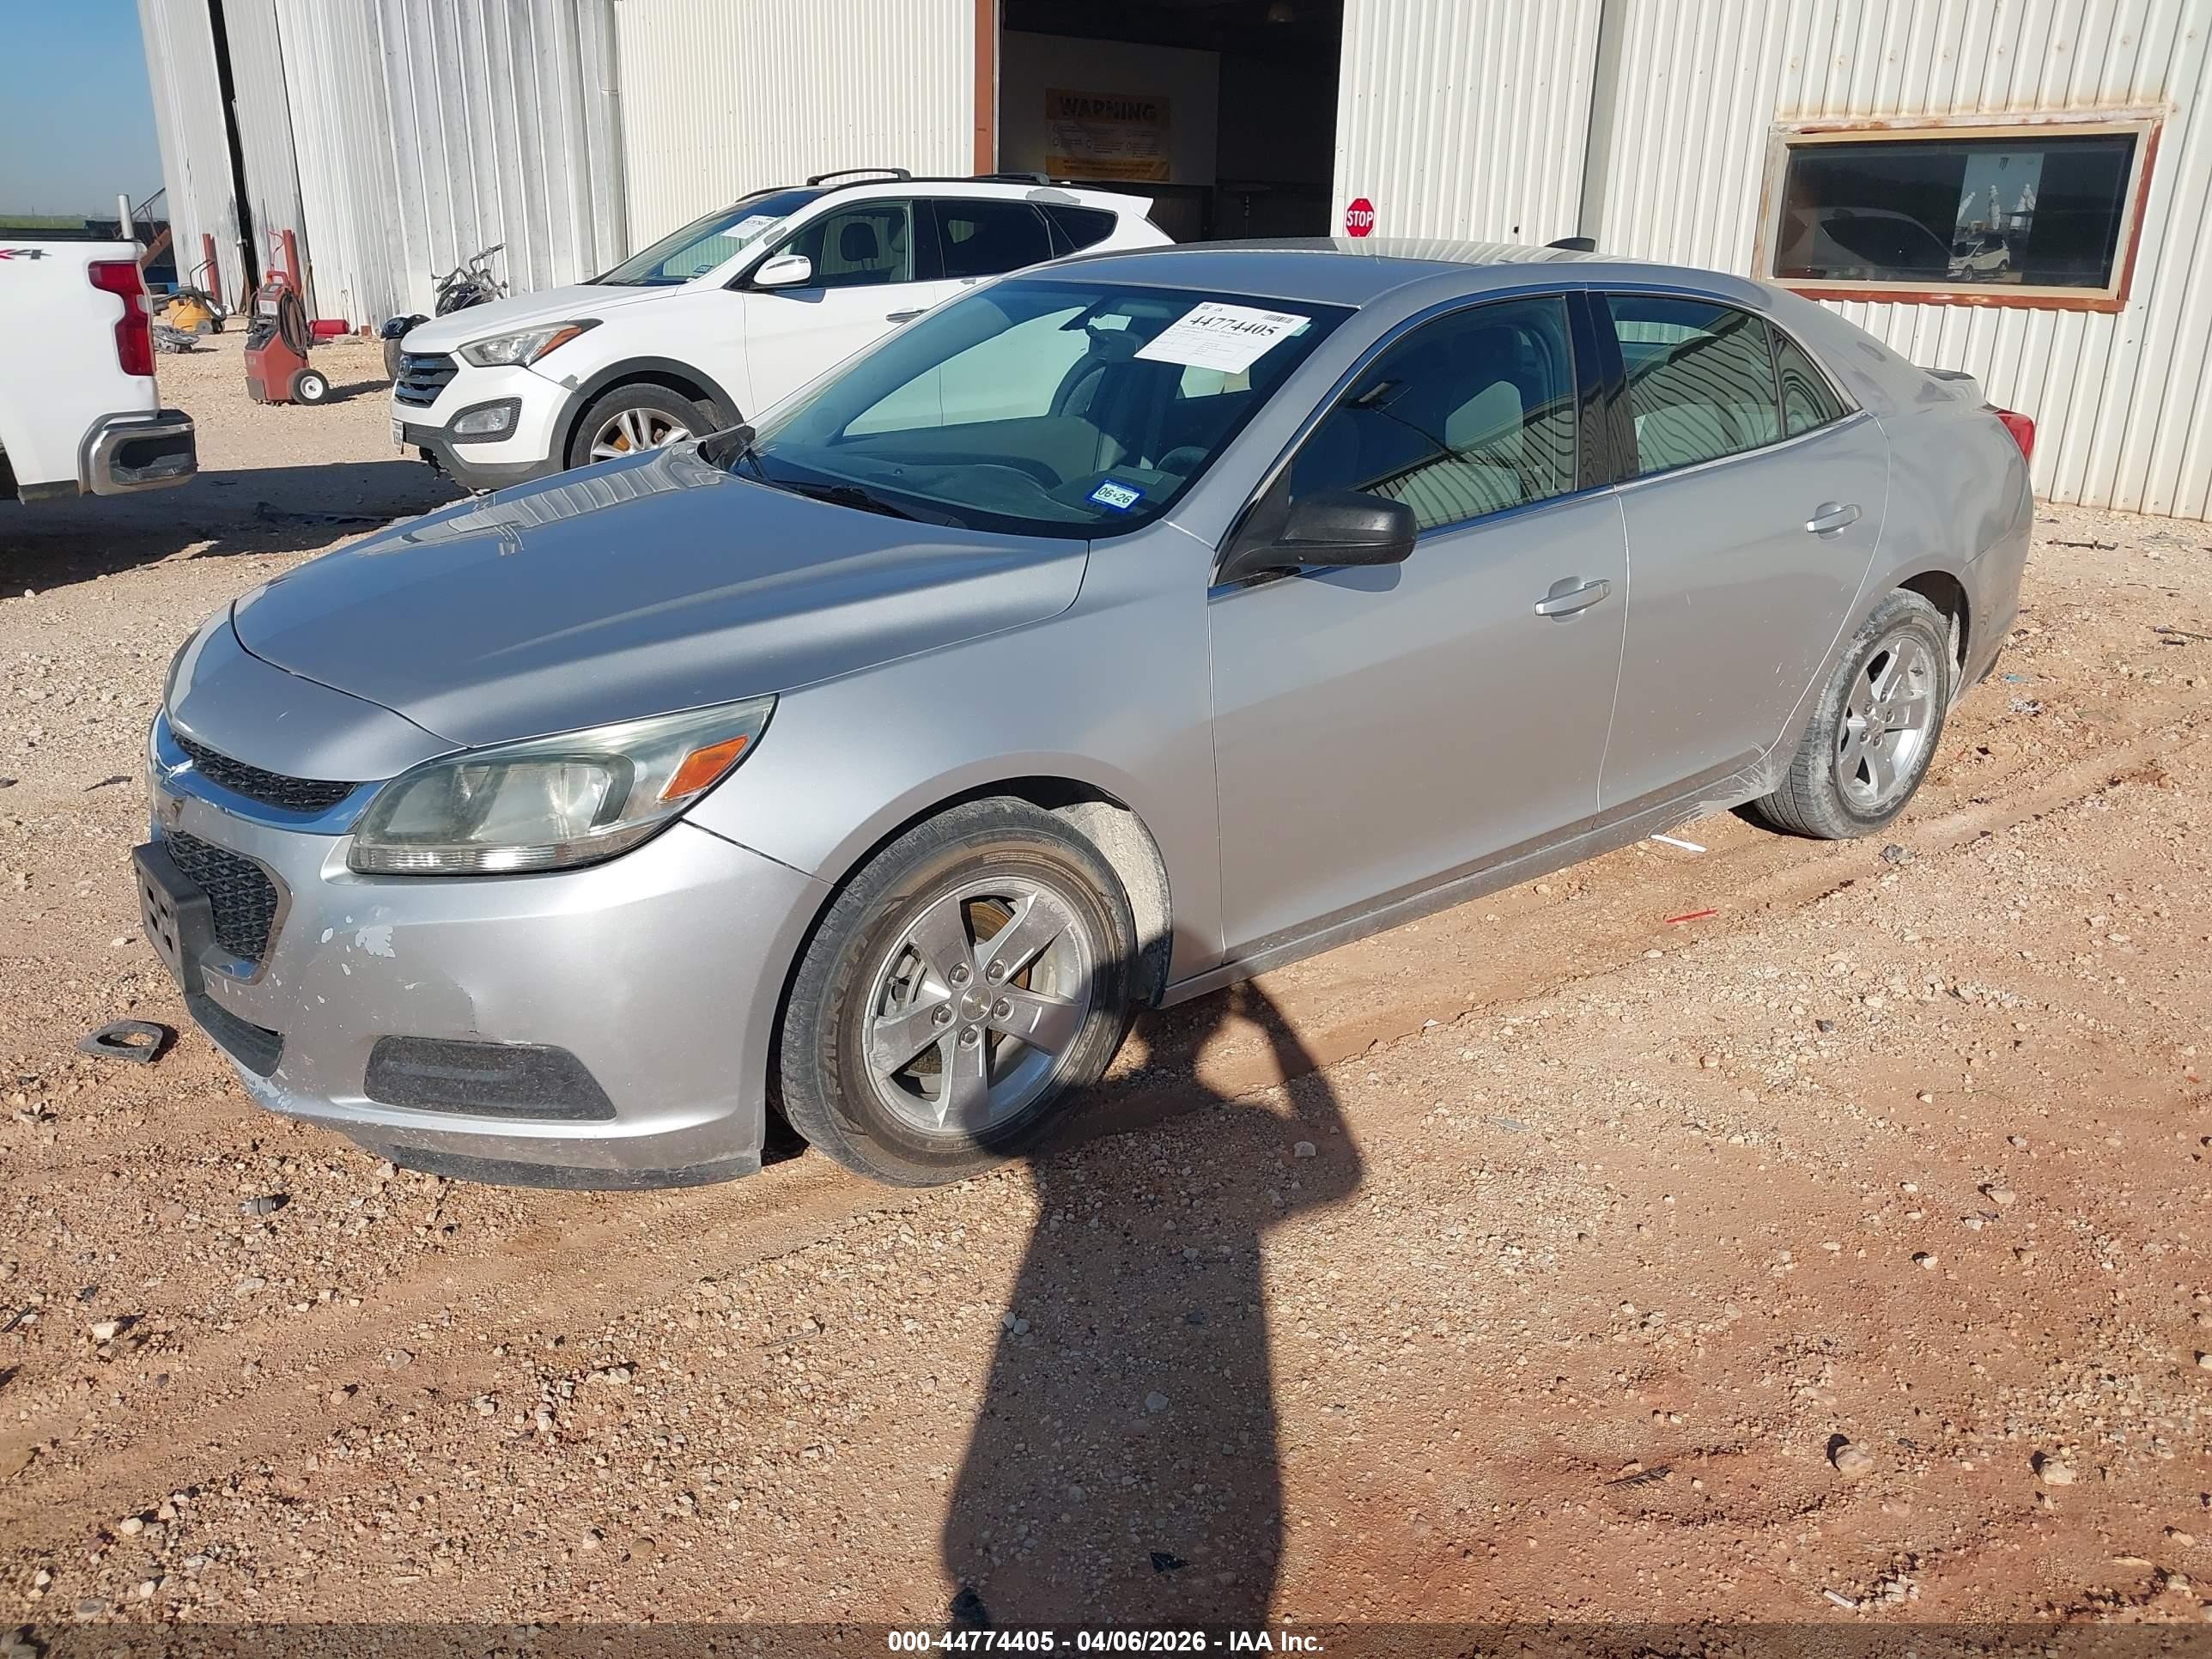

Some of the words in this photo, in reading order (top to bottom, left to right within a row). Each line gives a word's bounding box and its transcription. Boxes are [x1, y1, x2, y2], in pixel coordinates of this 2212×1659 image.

[1346, 210, 1374, 227] STOP
[1189, 314, 1280, 337] 44774405
[823, 934, 868, 1100] FALKEN
